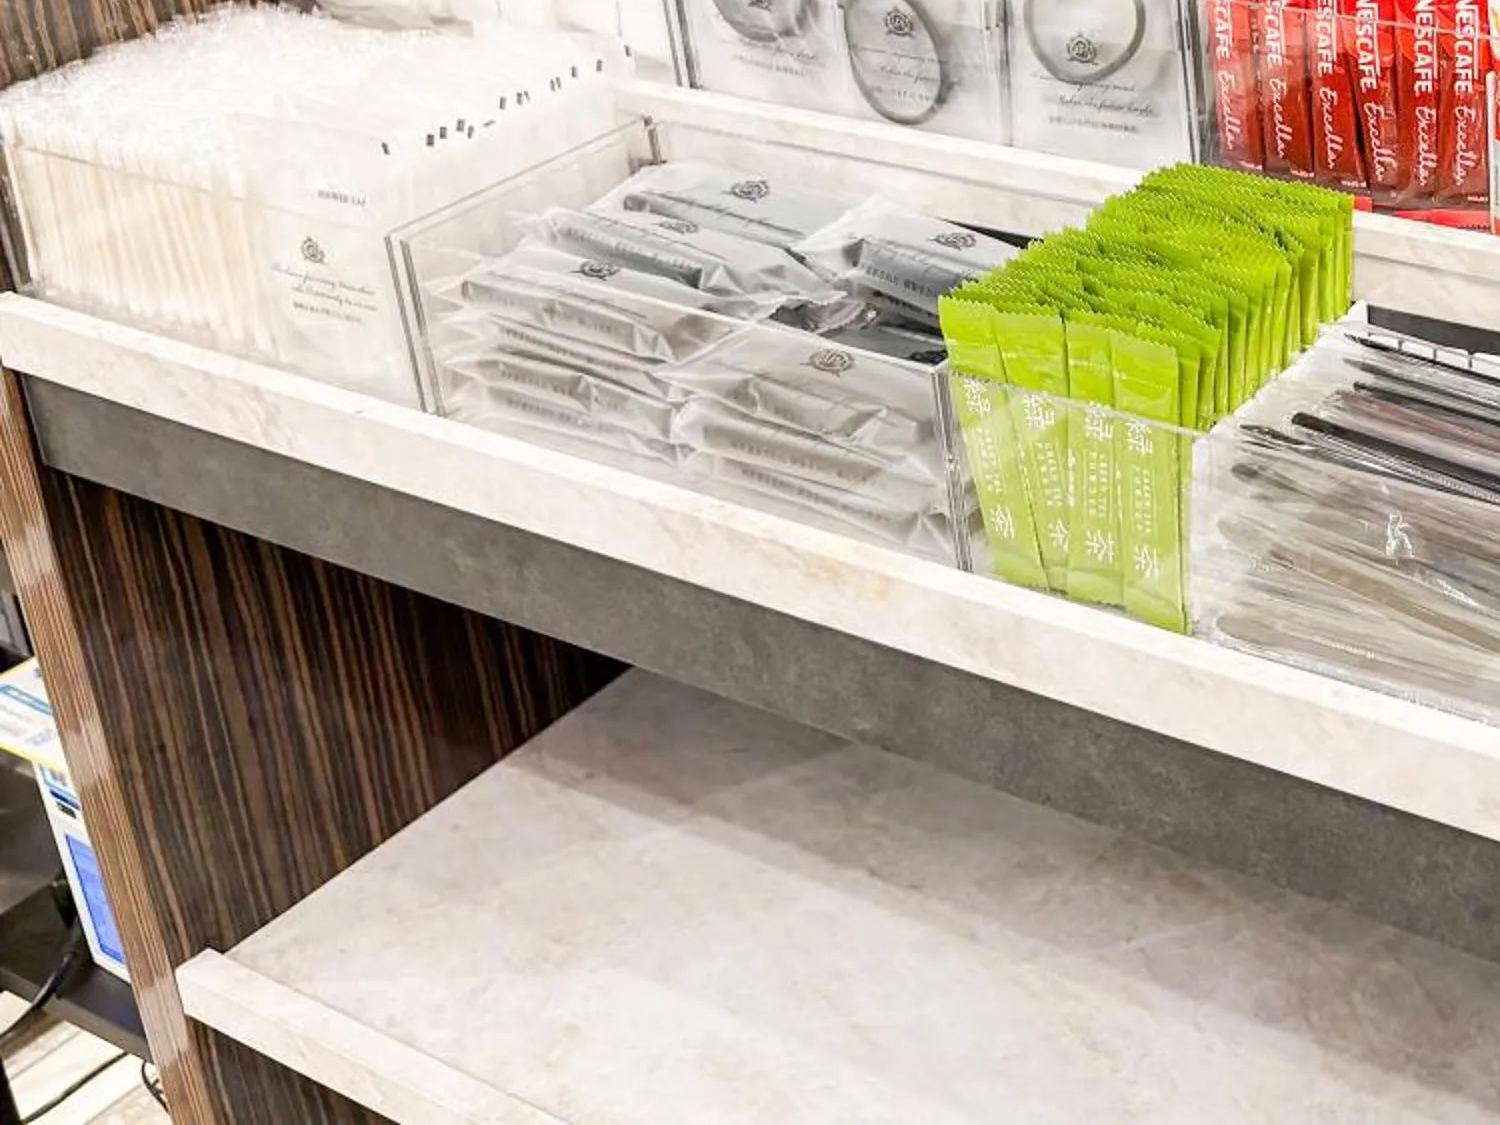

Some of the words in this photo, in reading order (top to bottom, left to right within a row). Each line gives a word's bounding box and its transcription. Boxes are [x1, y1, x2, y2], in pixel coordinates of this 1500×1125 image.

[990, 505, 1014, 539] 茶
[1084, 529, 1115, 563] 茶
[1134, 545, 1159, 583] 茶
